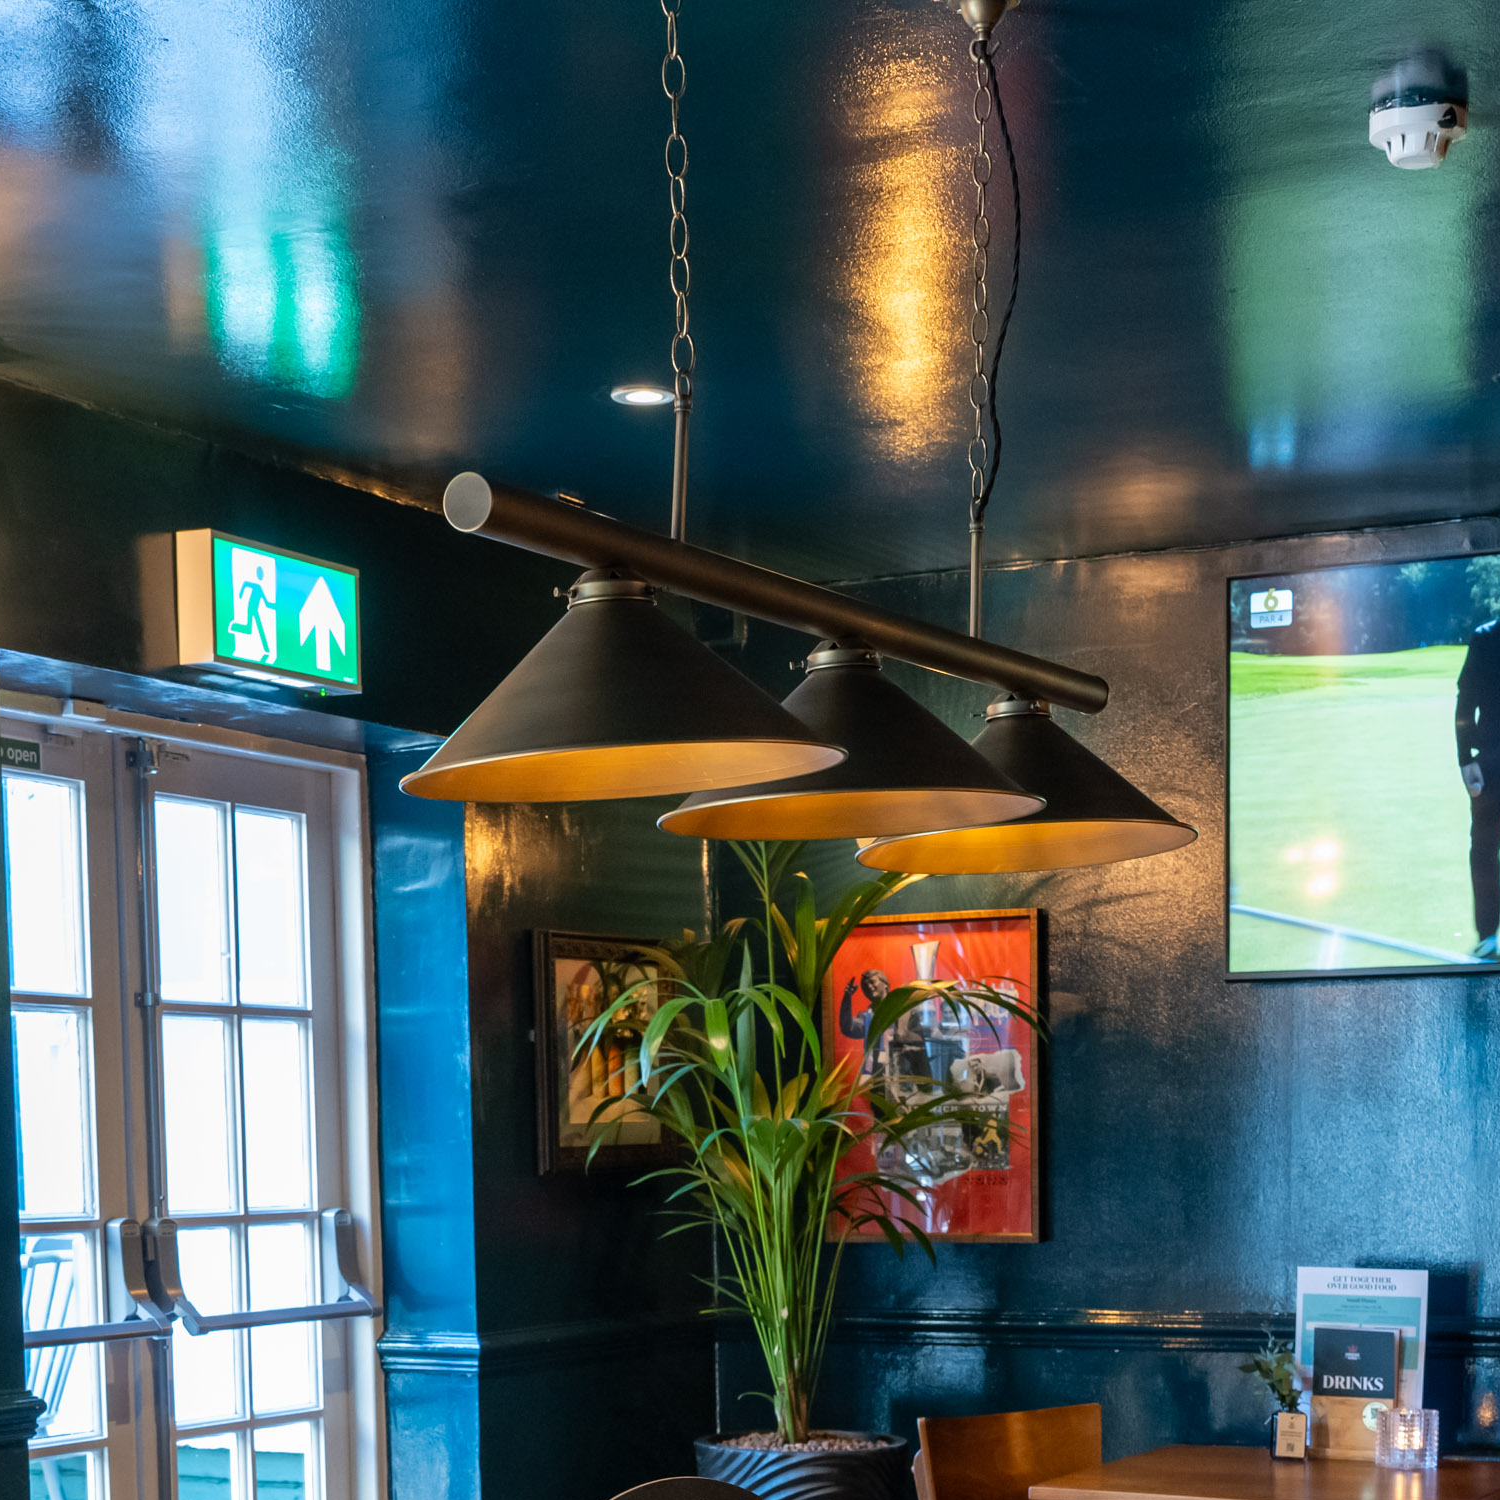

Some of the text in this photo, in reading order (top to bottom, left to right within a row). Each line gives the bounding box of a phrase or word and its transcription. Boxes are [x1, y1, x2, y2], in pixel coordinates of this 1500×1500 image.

[1264, 588, 1279, 612] 6
[1259, 615, 1284, 624] PAR 4
[7, 747, 37, 764] open
[971, 1104, 1008, 1113] TOWN
[1350, 1276, 1392, 1284] TOGETHER
[1322, 1374, 1384, 1392] DRINKS
